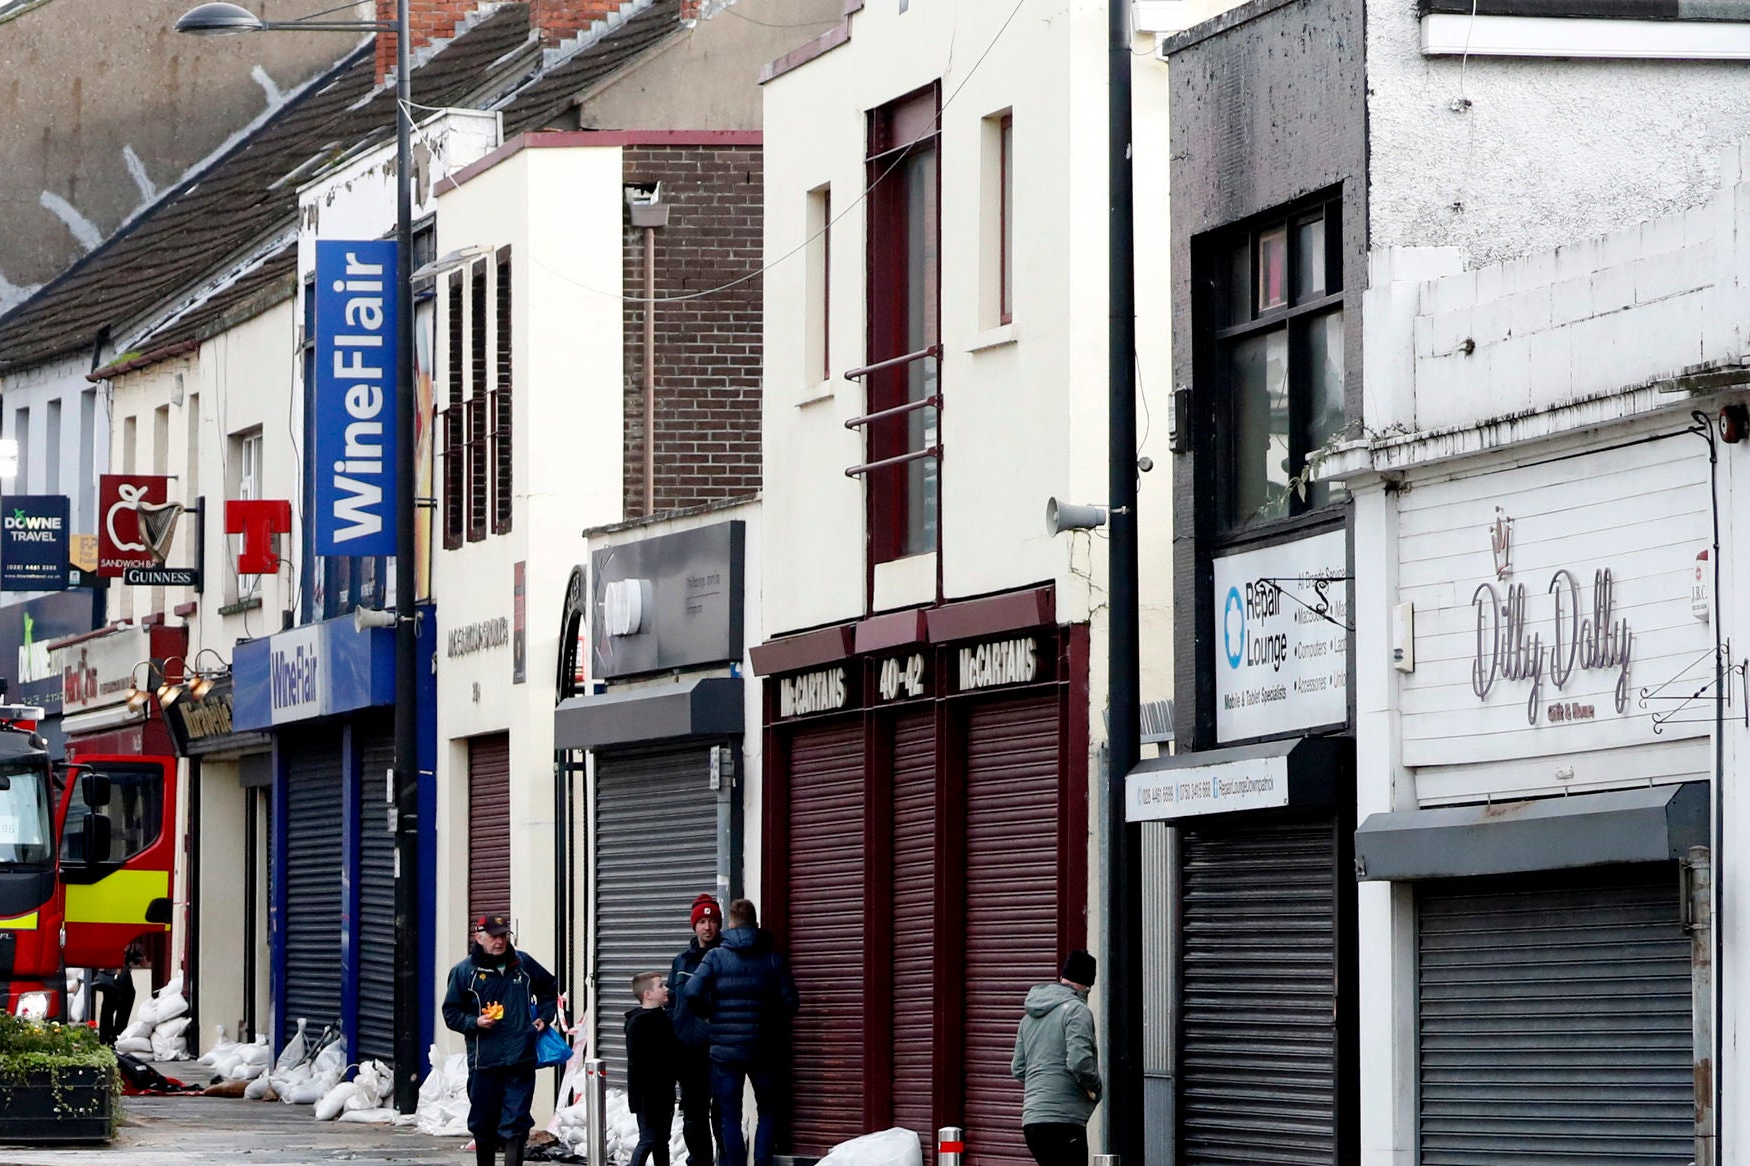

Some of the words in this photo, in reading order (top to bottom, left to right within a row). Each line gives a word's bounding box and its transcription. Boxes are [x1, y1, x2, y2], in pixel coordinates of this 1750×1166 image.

[333, 252, 384, 543] WineFlair
[4, 516, 62, 529] DOWNE
[11, 531, 56, 542] TRAVEL
[225, 500, 291, 574] T
[101, 559, 143, 568] SANDWICH
[129, 569, 192, 583] GUINNESS
[1246, 582, 1281, 626] Repair
[959, 638, 1037, 691] McCARTANS
[1247, 629, 1287, 672] Lounge
[1472, 583, 1544, 725] Dilly
[1549, 567, 1633, 713] Dally
[271, 643, 318, 709] WineFlair
[780, 668, 846, 717] McCARTANS
[879, 653, 925, 700] 40-42
